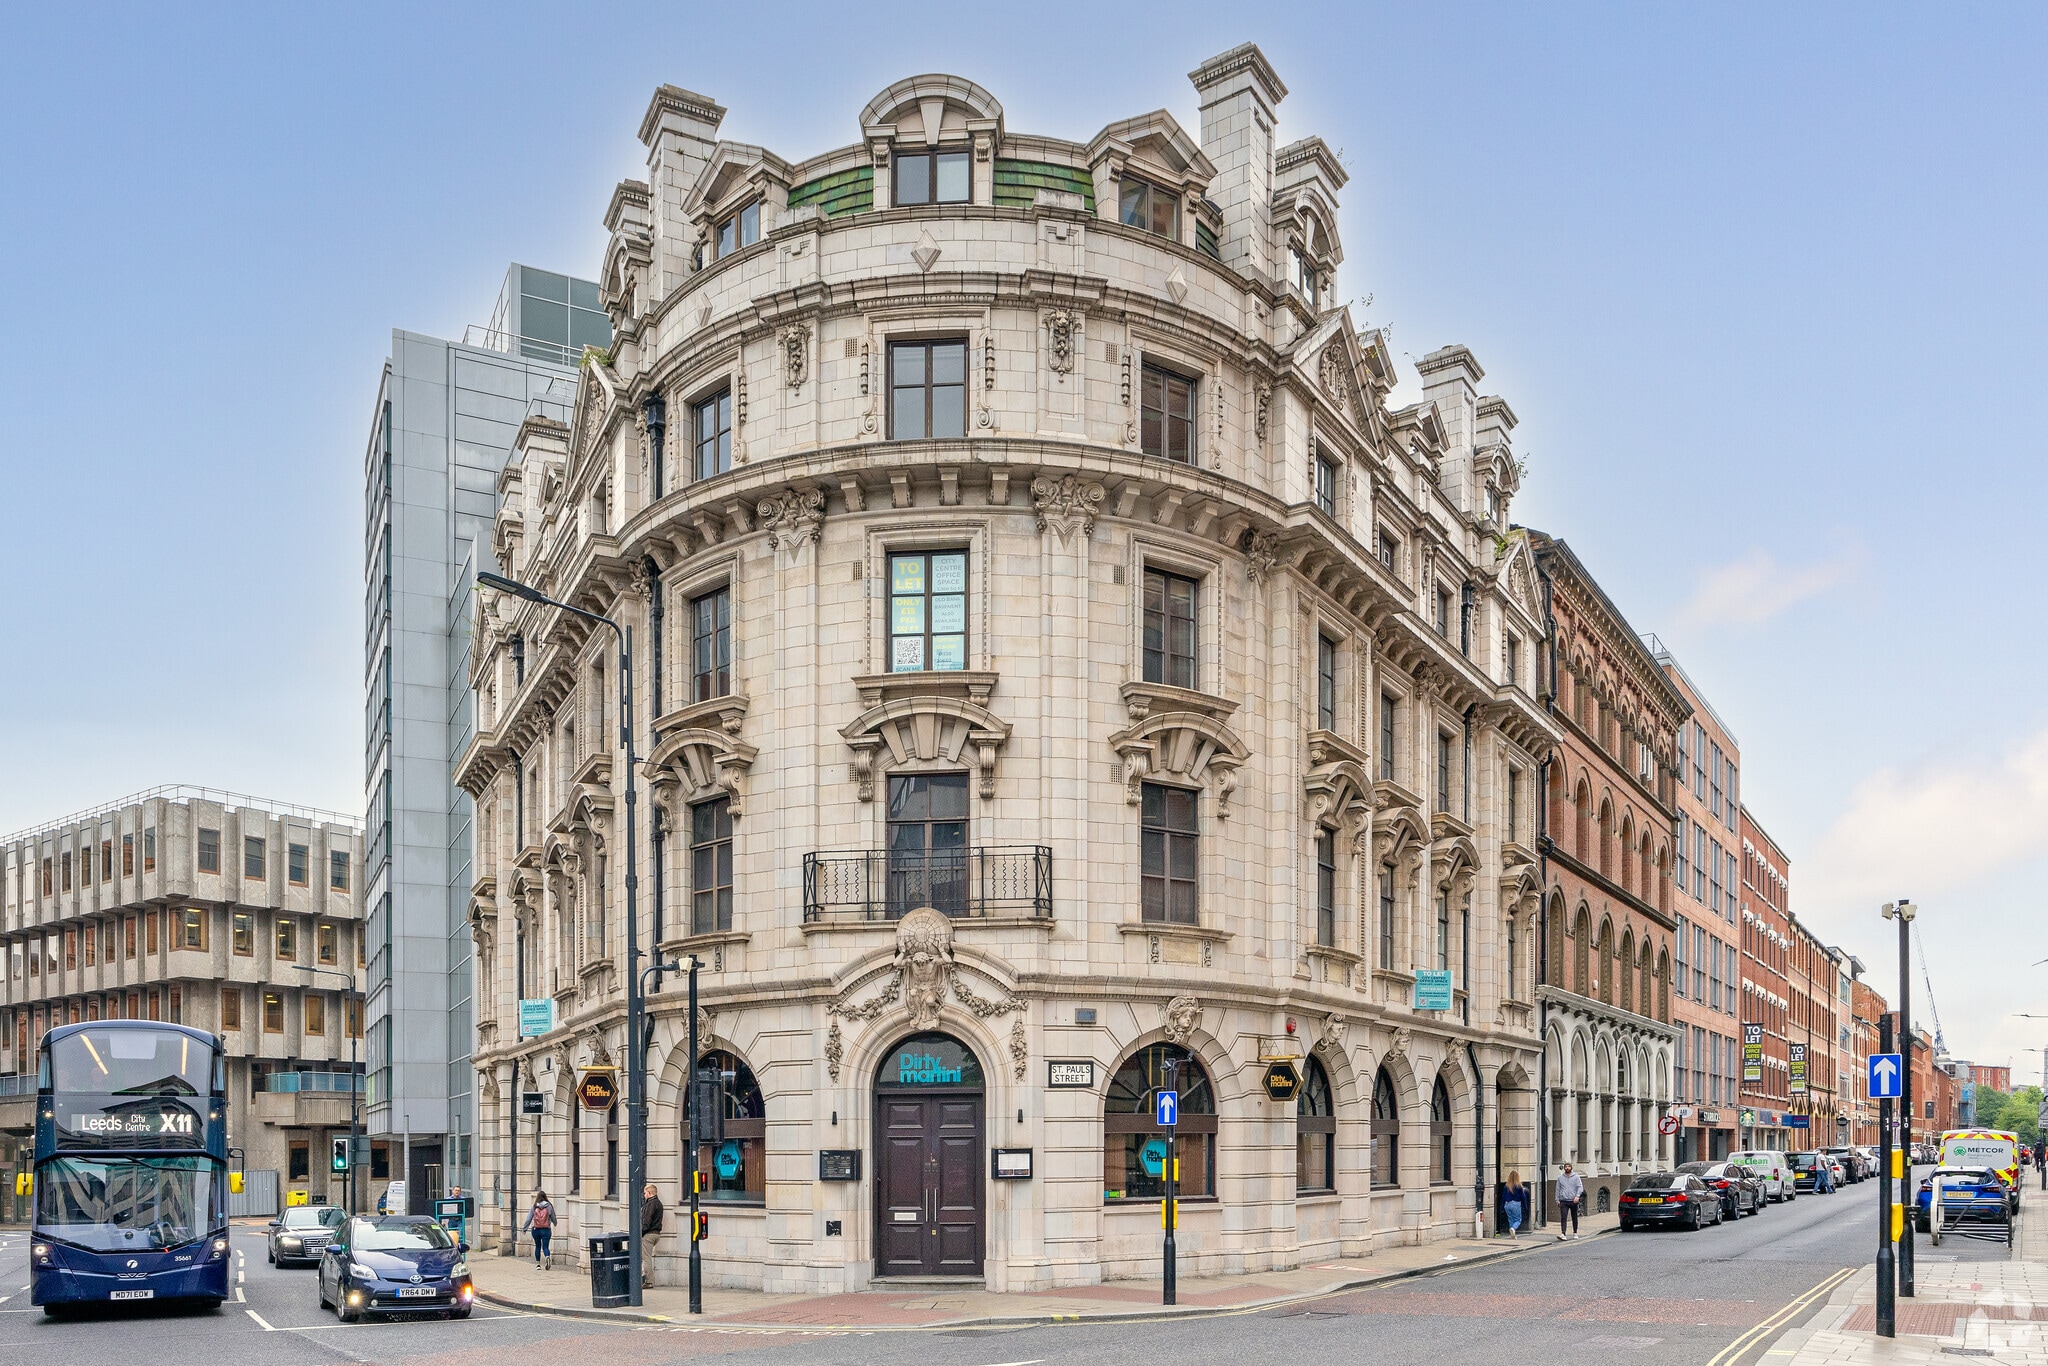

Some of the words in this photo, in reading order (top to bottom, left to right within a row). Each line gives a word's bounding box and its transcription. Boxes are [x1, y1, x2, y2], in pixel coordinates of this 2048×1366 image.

[898, 562, 920, 574] TO
[896, 577, 922, 590] LET
[1745, 1035, 1761, 1043] LET
[900, 1053, 941, 1070] Dirty
[900, 1066, 961, 1083] martini
[81, 1115, 122, 1130] Leeds
[159, 1114, 192, 1132] X11
[131, 1114, 145, 1123] City
[125, 1123, 150, 1131] Centre
